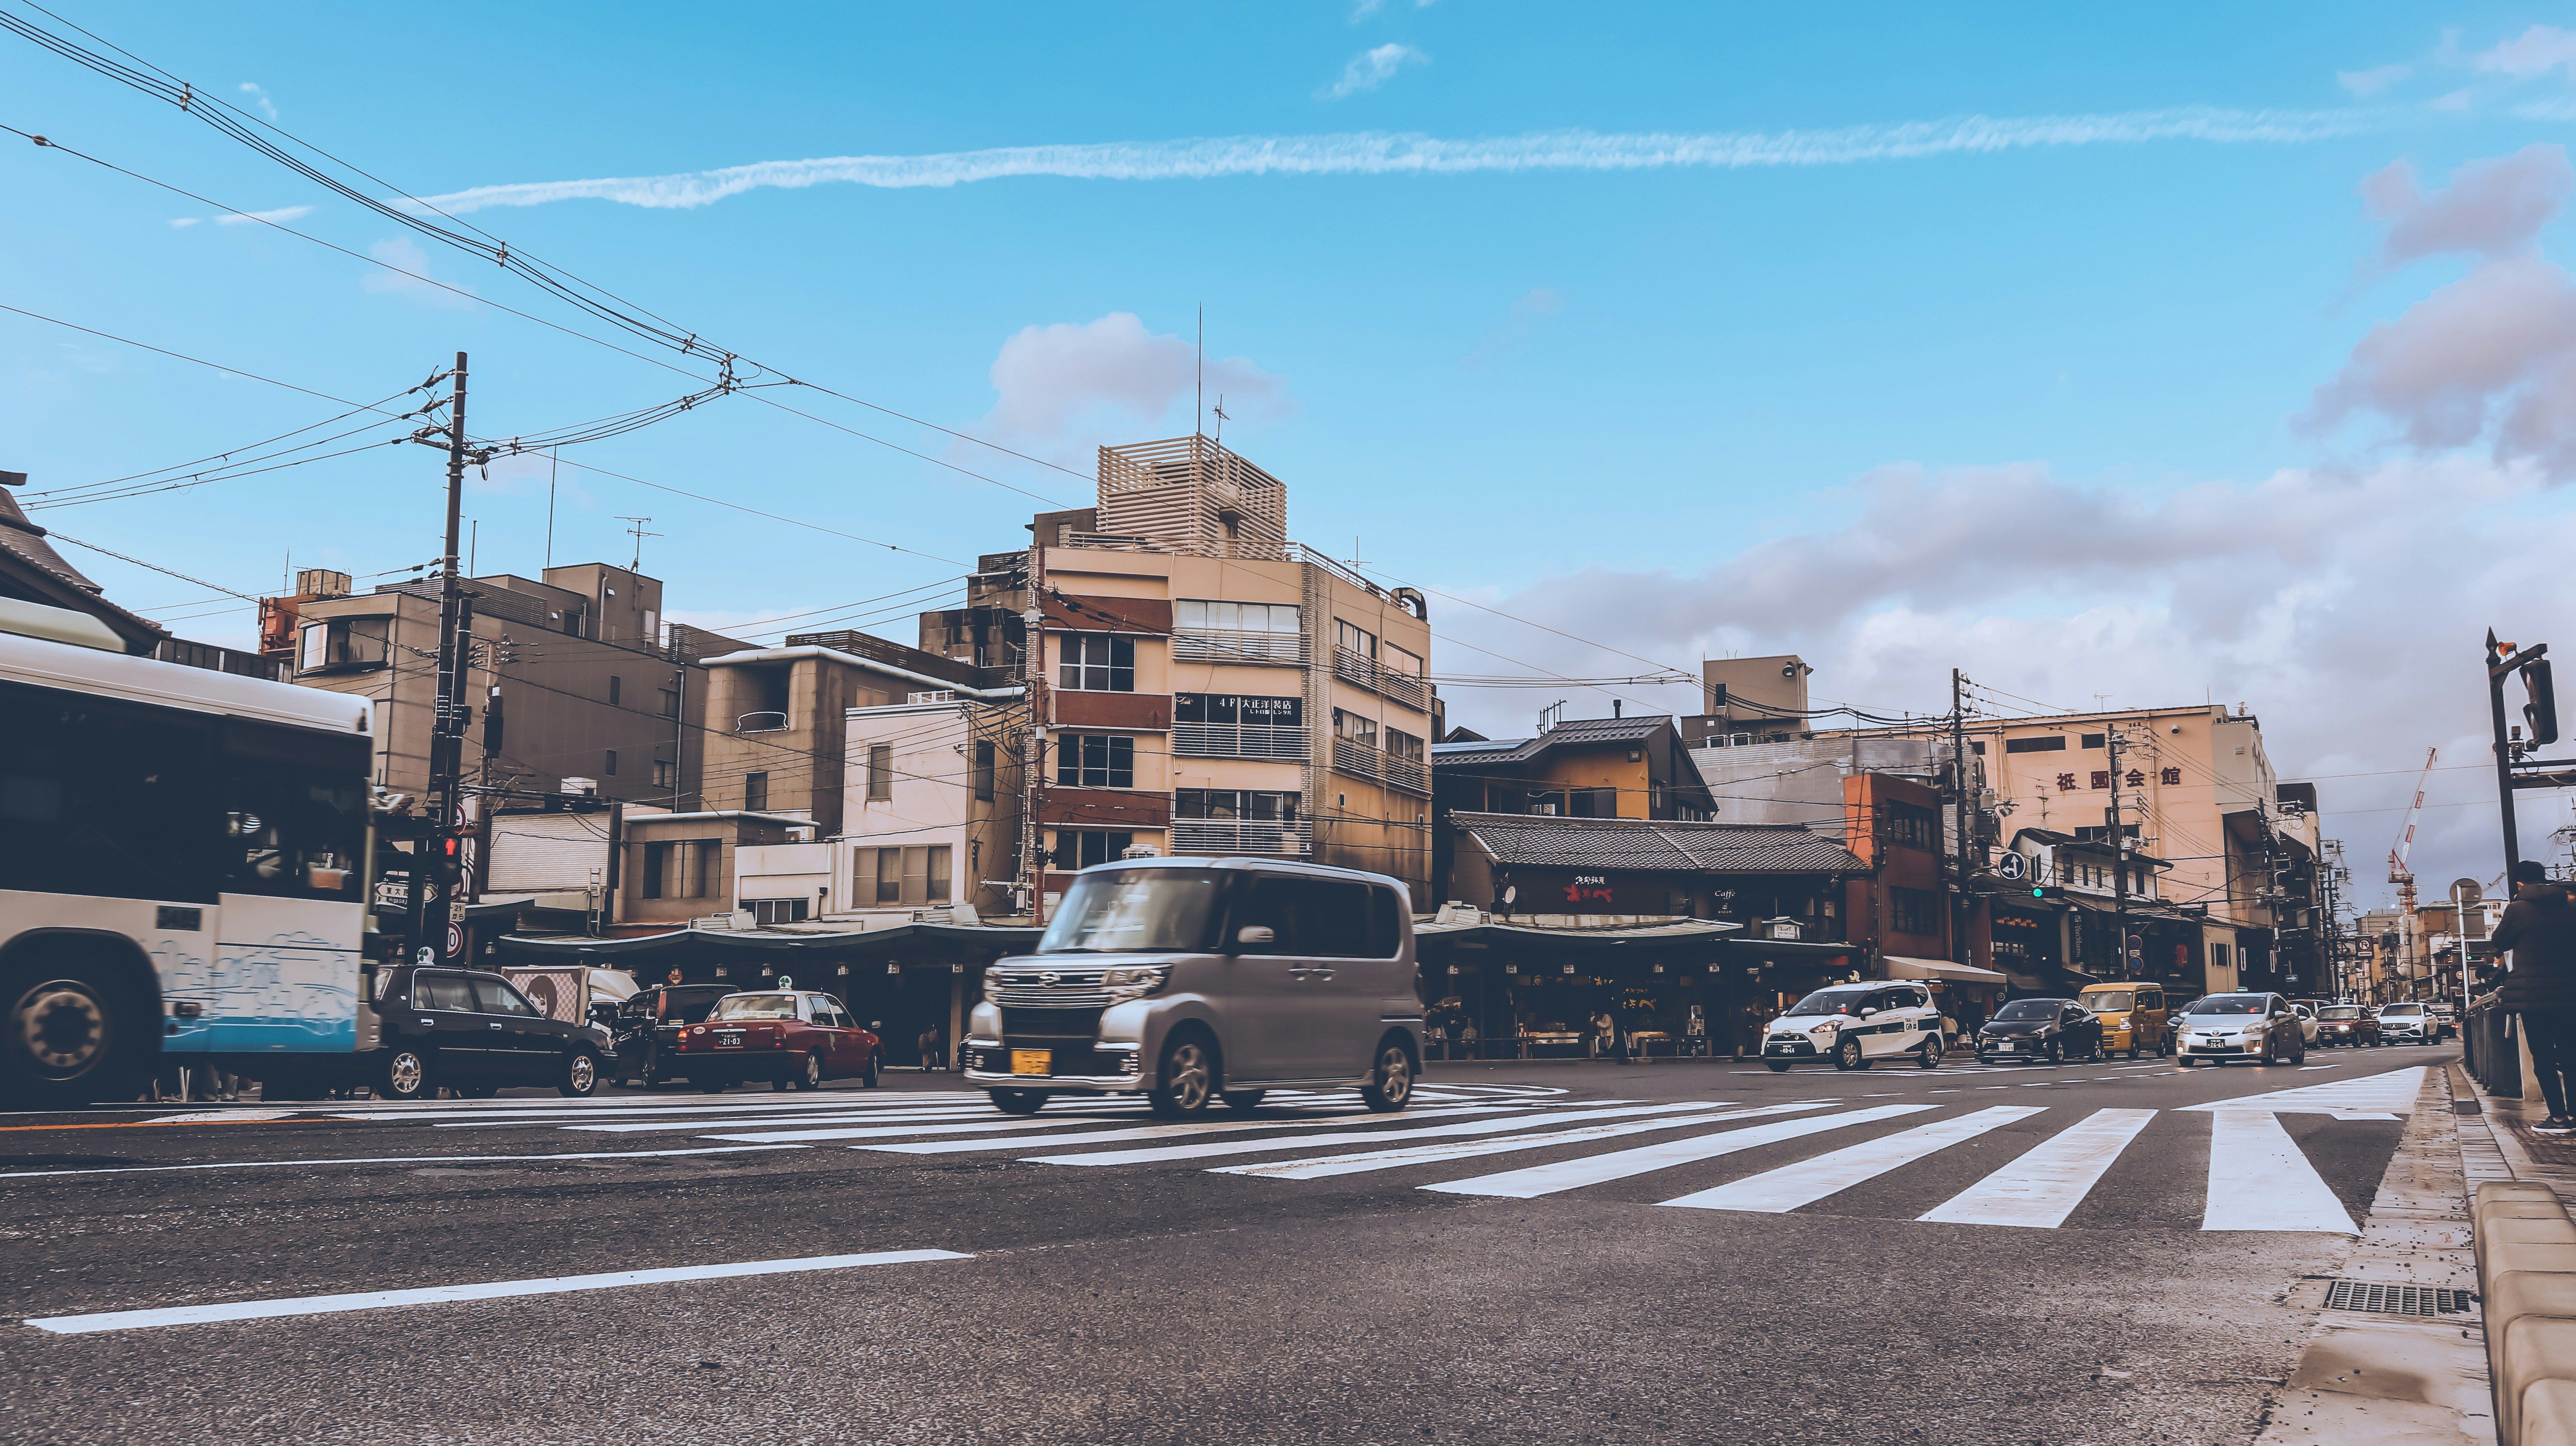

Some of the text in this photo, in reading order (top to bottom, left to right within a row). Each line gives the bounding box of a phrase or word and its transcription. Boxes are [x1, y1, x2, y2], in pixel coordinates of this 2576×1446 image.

[1241, 699, 1292, 709] 大正洋装店
[449, 932, 456, 947] 0
